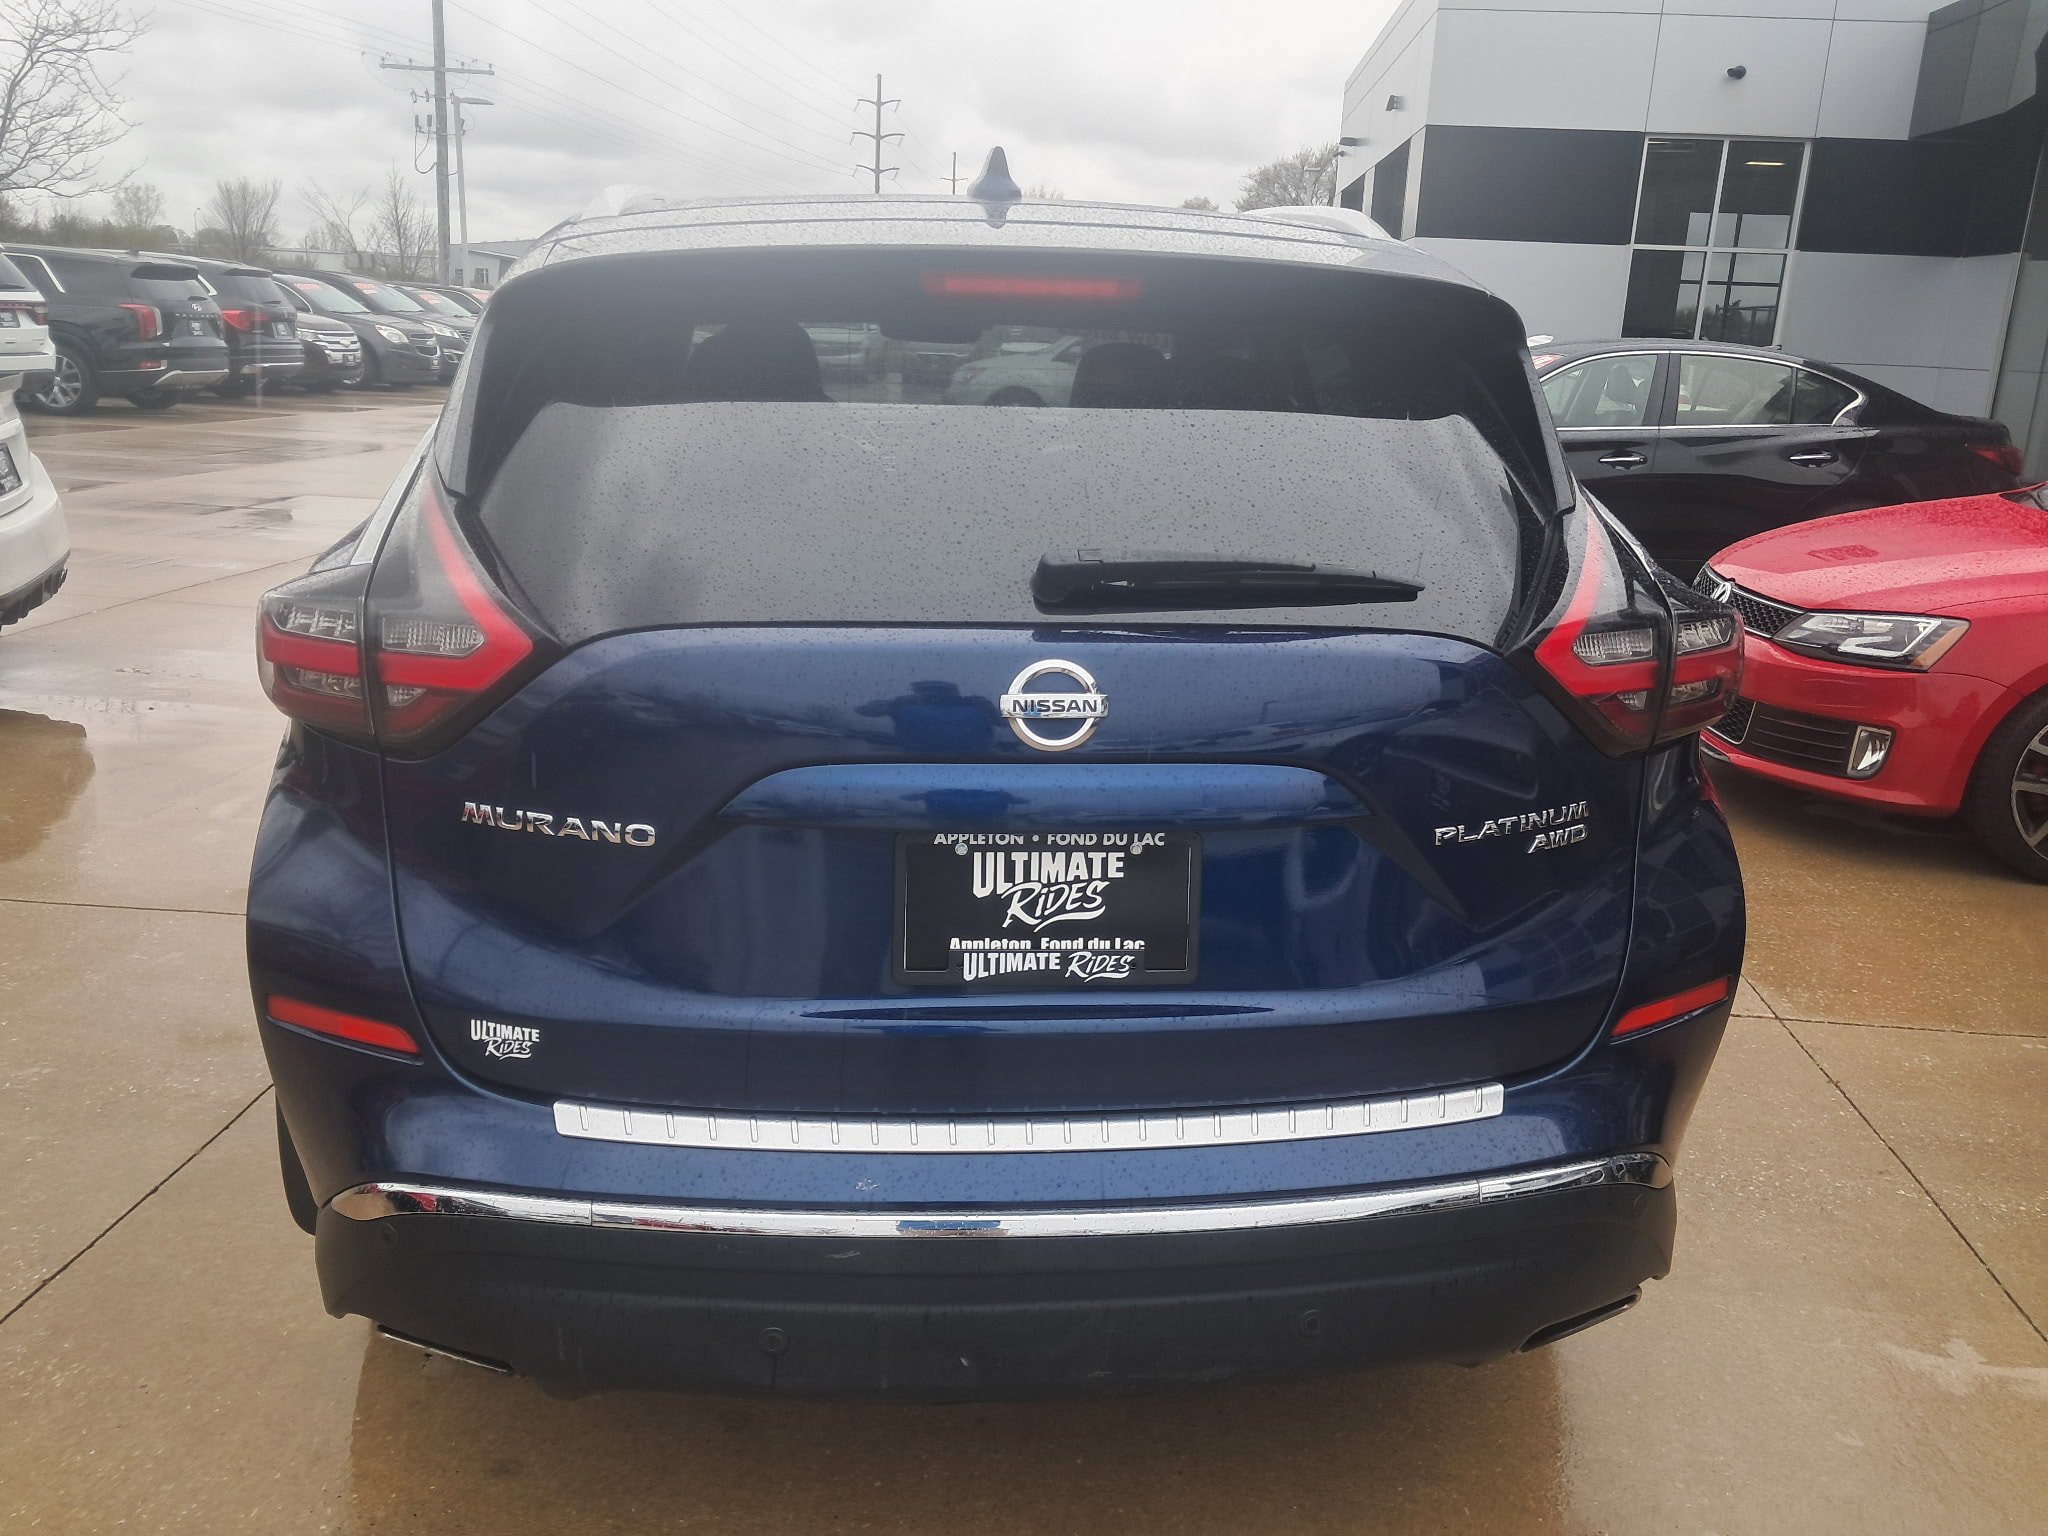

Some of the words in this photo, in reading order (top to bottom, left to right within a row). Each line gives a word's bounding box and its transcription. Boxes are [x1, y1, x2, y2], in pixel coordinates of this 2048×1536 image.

[1012, 699, 1098, 713] NISSAN
[461, 801, 657, 847] MURANO
[1434, 801, 1590, 846] PLATINUM
[933, 833, 1025, 845] APPLETON
[1047, 833, 1098, 846] FOND
[1102, 833, 1128, 846] DU
[1133, 832, 1166, 846] LAC
[1527, 824, 1588, 854] AWD
[972, 851, 1126, 899] ULTIMATE
[963, 952, 1061, 982] ULTIMATE
[470, 1019, 541, 1042] ULTIMATE
